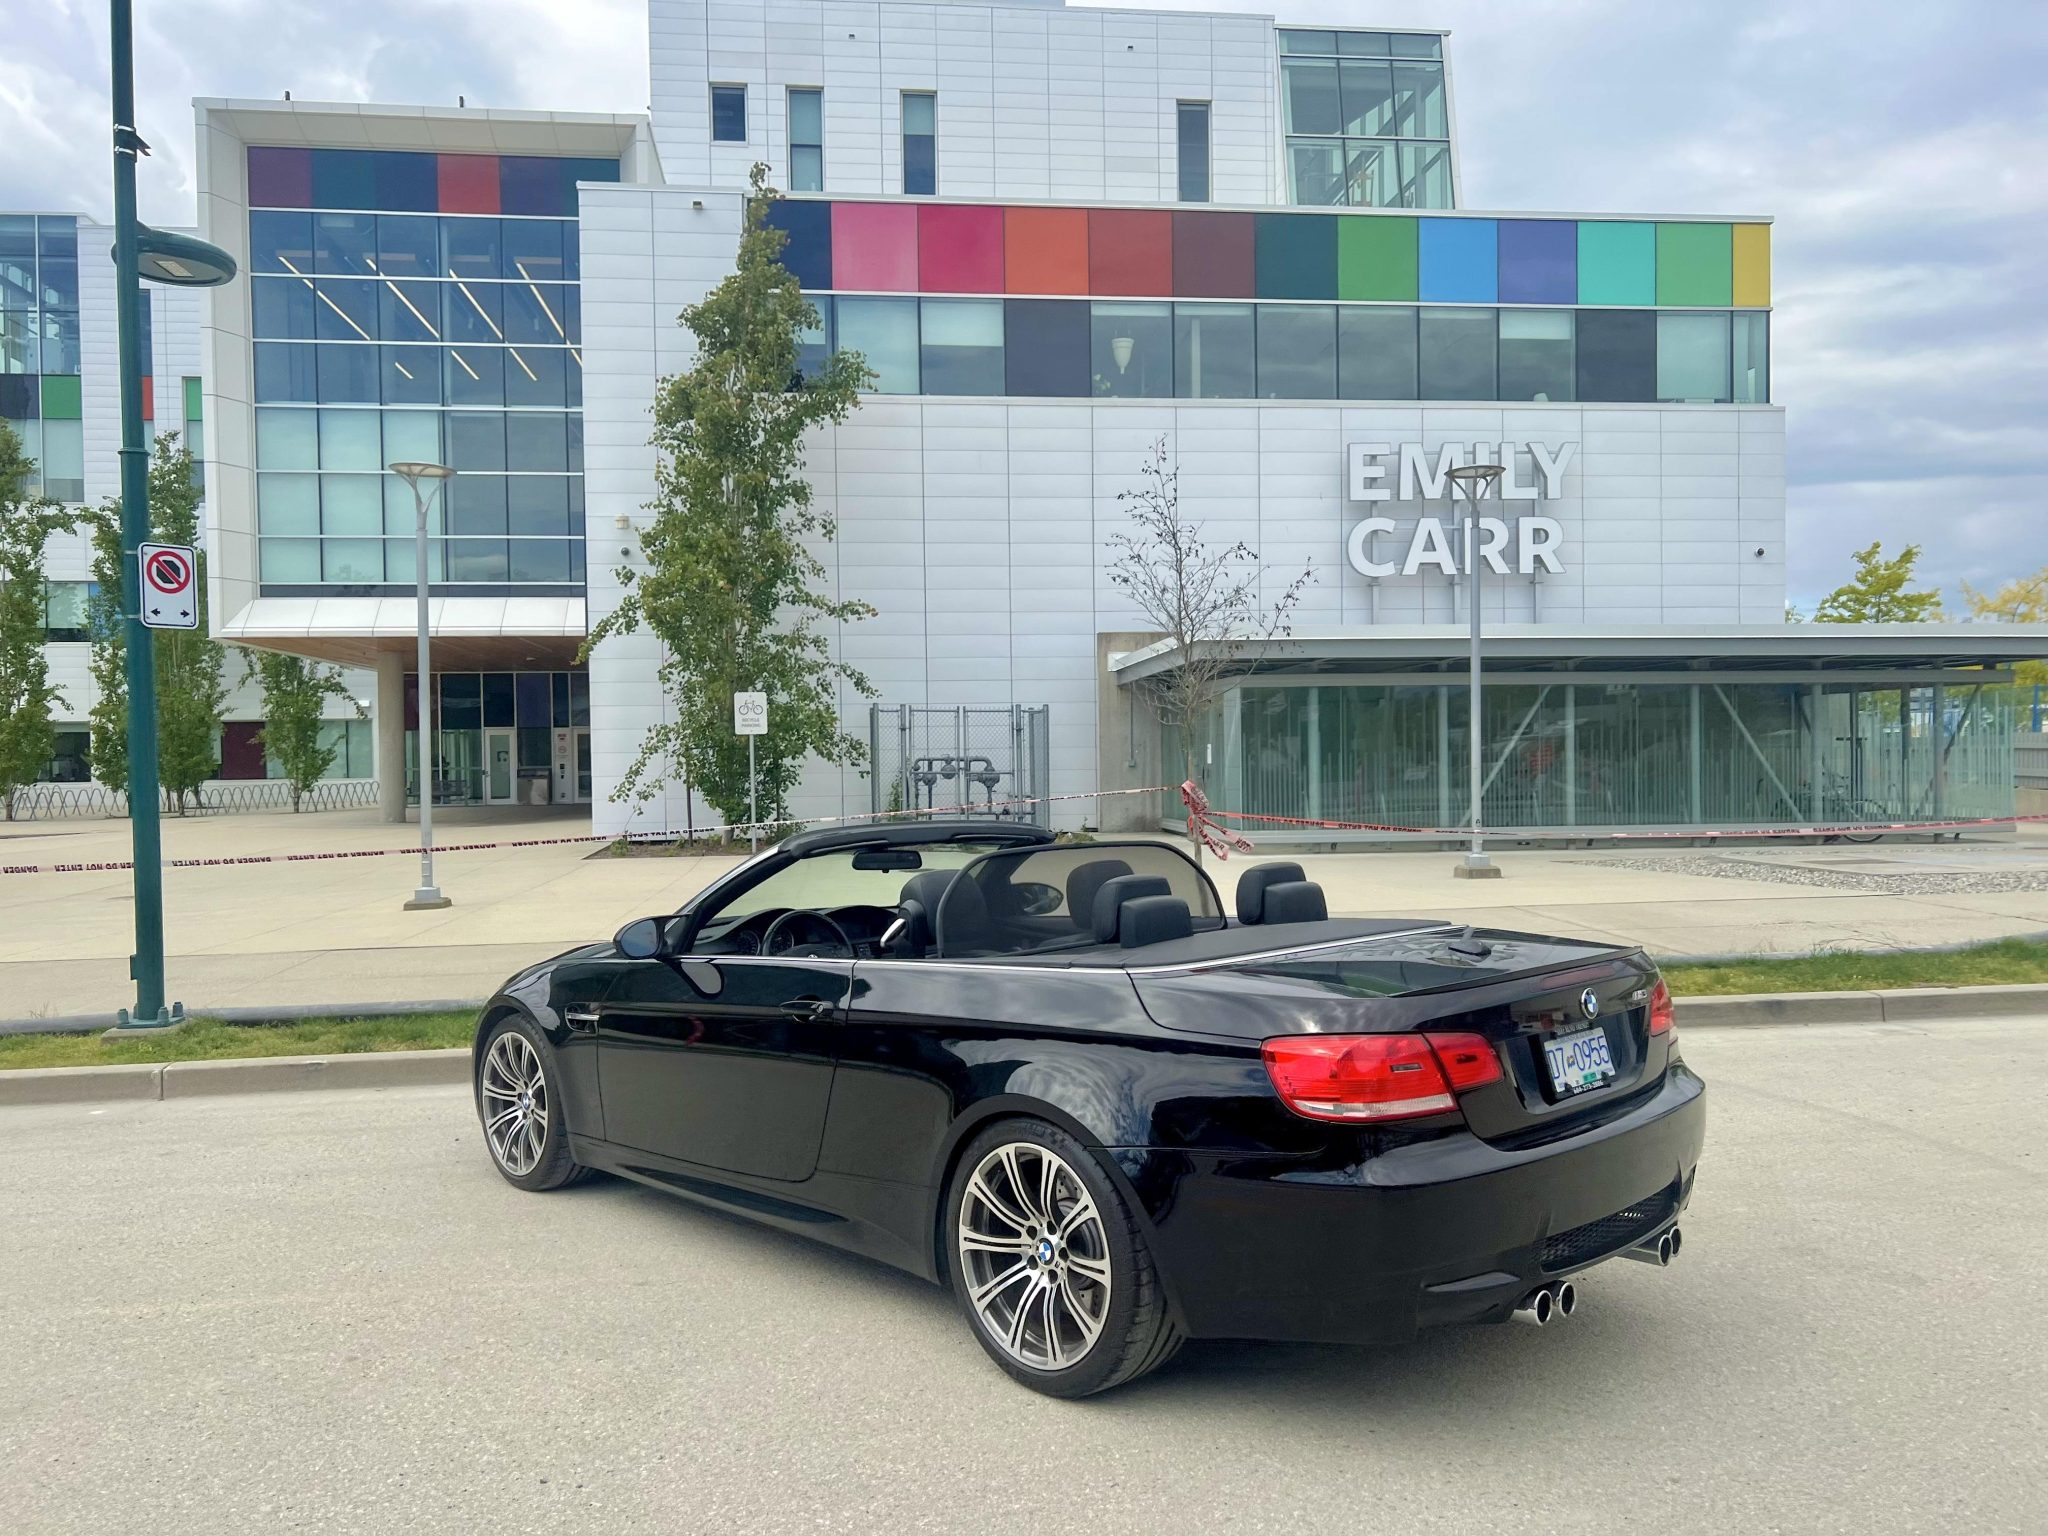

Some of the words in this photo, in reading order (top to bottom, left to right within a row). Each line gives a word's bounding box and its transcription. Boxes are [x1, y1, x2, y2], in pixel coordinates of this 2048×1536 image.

[1348, 441, 1580, 501] EMILY
[1347, 516, 1567, 578] CARR
[3, 865, 38, 874] DANGER
[54, 864, 83, 872] ENTER
